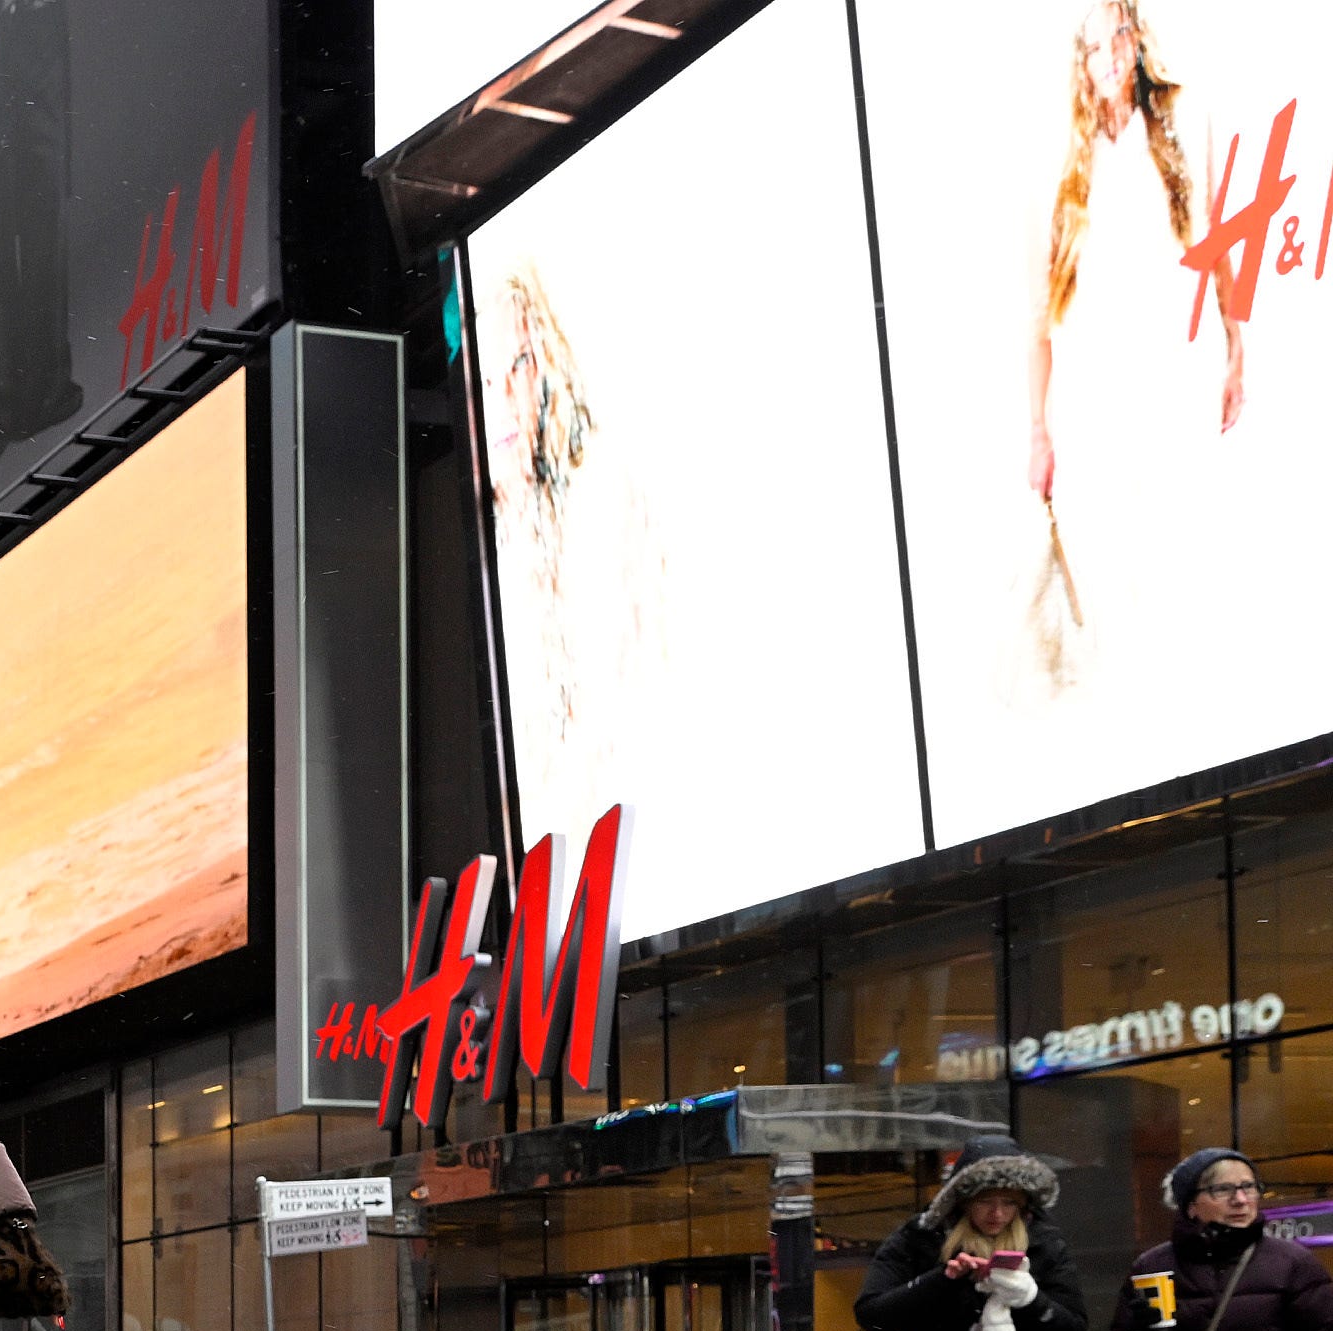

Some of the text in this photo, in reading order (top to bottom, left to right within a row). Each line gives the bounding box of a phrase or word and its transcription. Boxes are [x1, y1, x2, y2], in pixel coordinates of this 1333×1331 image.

[118, 110, 257, 391] H&M
[1181, 98, 1333, 342] H&
[316, 1002, 391, 1062] H&M
[376, 804, 627, 1127] H&M
[279, 1184, 385, 1200] PEDESTRIAN FLOW ZONE
[280, 1200, 339, 1212] KEEP MOVING
